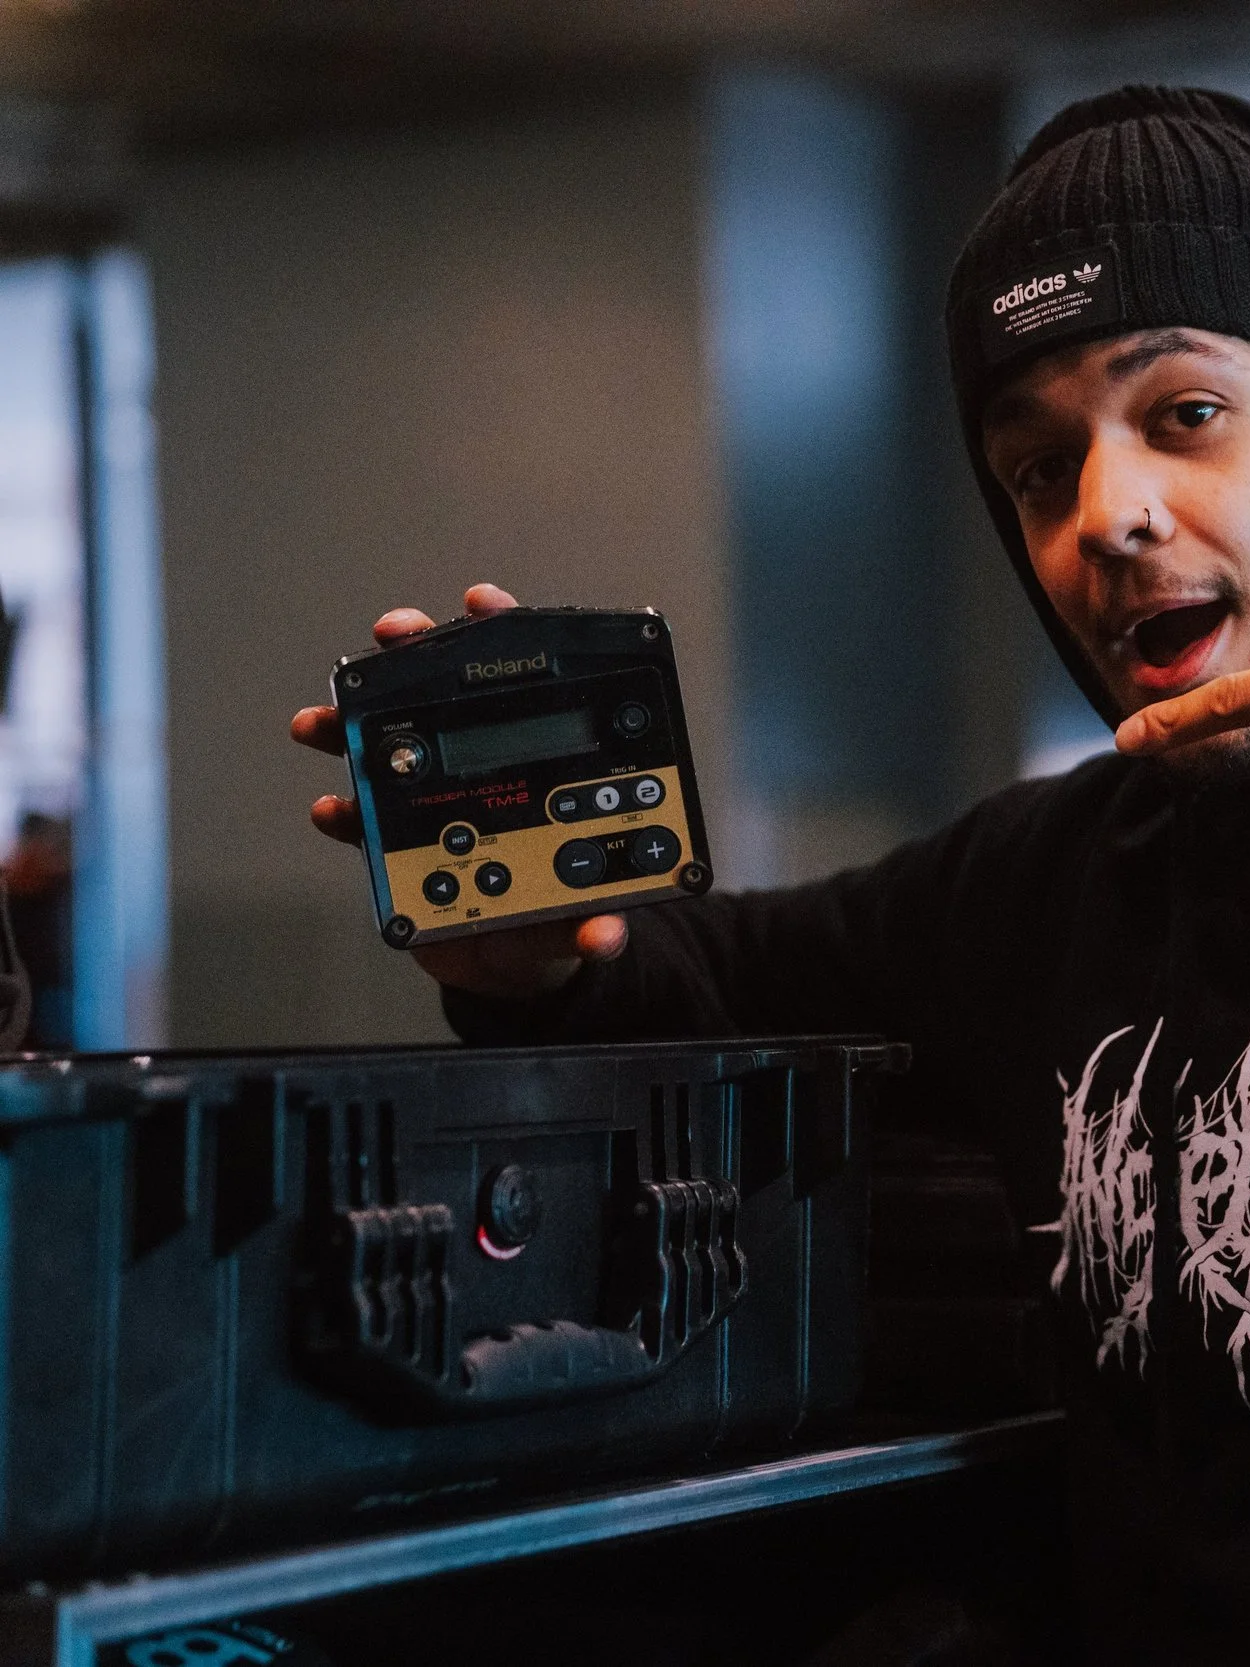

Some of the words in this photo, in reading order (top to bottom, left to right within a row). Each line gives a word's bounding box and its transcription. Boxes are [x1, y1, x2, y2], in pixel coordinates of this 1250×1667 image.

[993, 273, 1067, 315] adidas
[1018, 307, 1035, 318] BRAND
[1048, 298, 1058, 306] THE
[1062, 290, 1086, 302] STRIPES
[1059, 307, 1082, 319] BANDES
[465, 652, 547, 682] Roland
[382, 720, 414, 733] VOLUME
[610, 767, 626, 775] TRIG
[628, 765, 636, 773] IN
[411, 789, 466, 807] TRIGGER
[470, 779, 527, 797] MODULE
[483, 791, 530, 809] TM-2
[603, 793, 612, 805] 1
[640, 786, 656, 799] 2
[452, 835, 468, 845] INST
[606, 839, 625, 850] KIT
